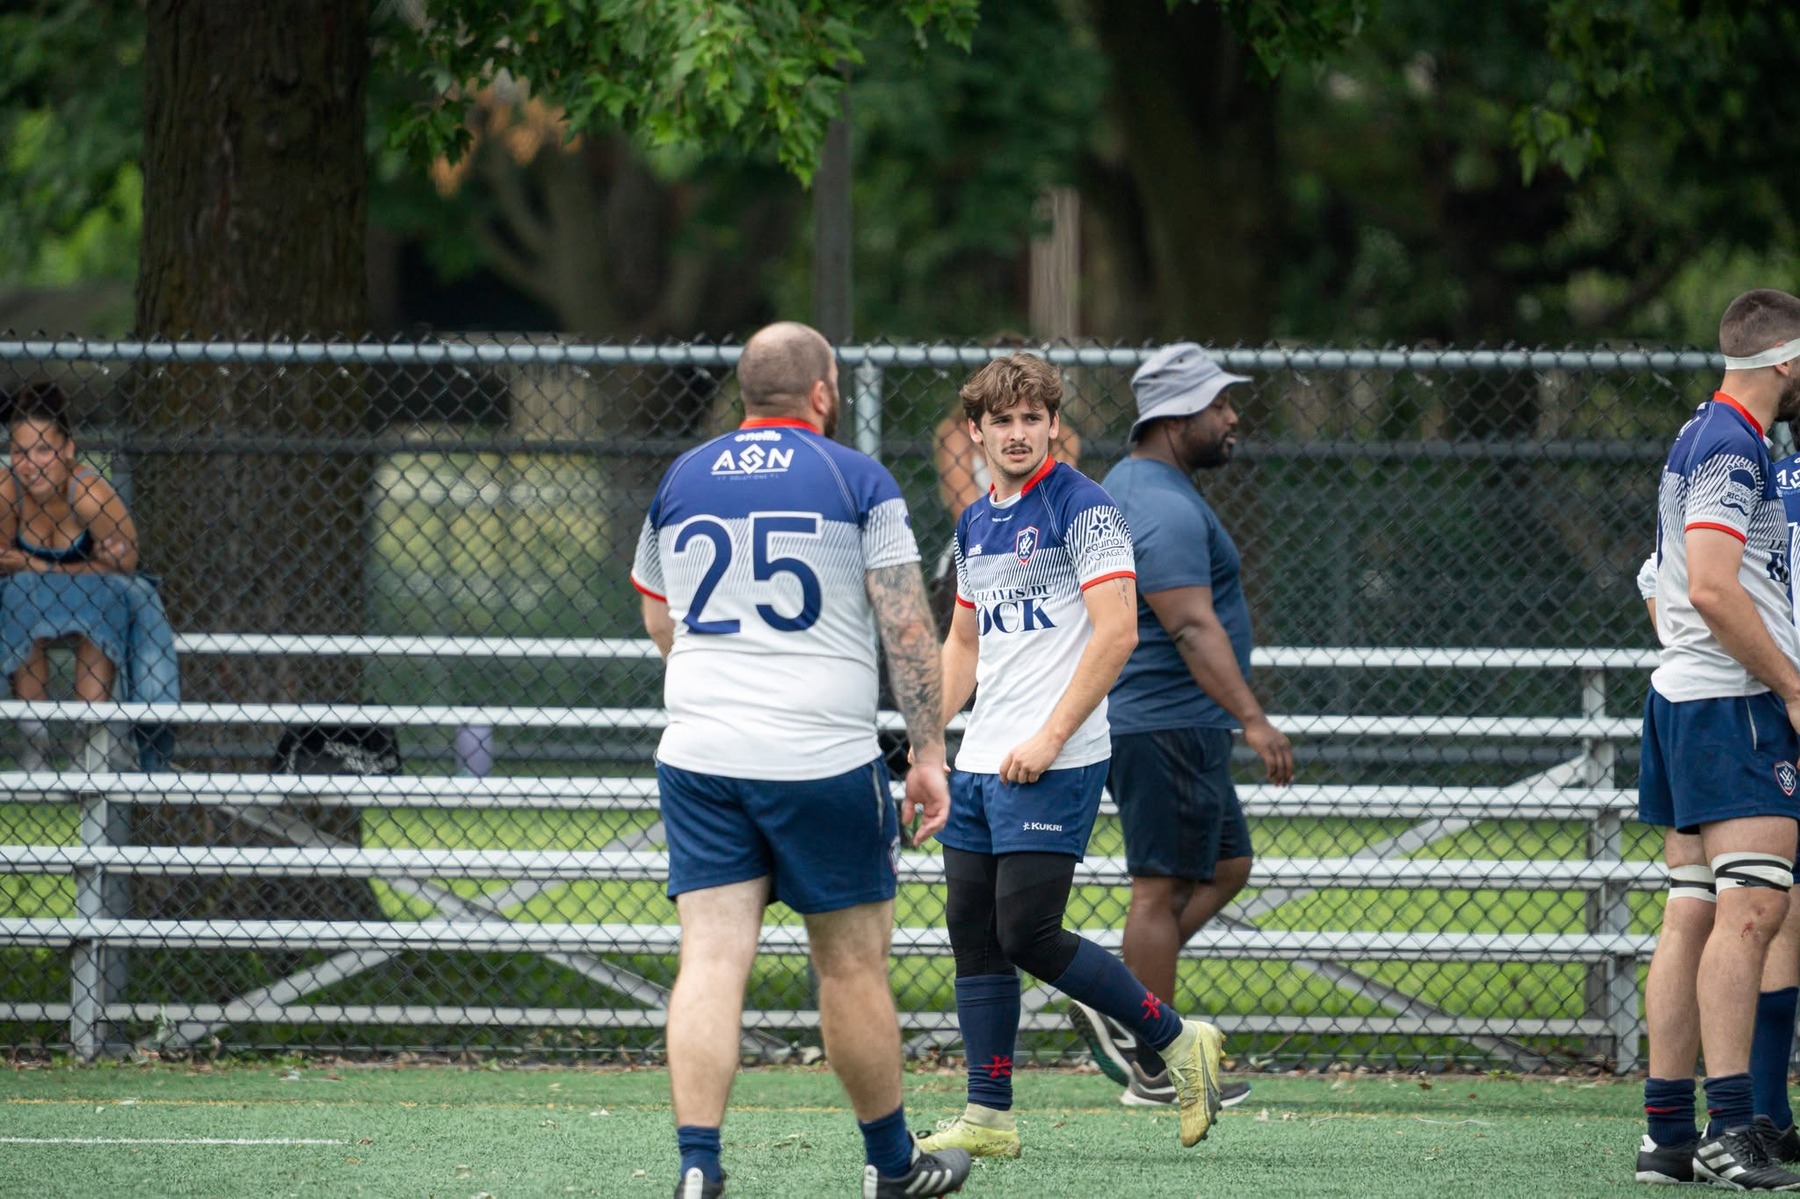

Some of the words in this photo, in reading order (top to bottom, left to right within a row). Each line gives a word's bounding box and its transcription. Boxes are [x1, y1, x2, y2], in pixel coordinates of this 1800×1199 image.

[1085, 537, 1125, 554] equinox
[673, 511, 823, 635] 25
[976, 596, 1058, 637] OCK
[1031, 822, 1063, 832] KUKRI
